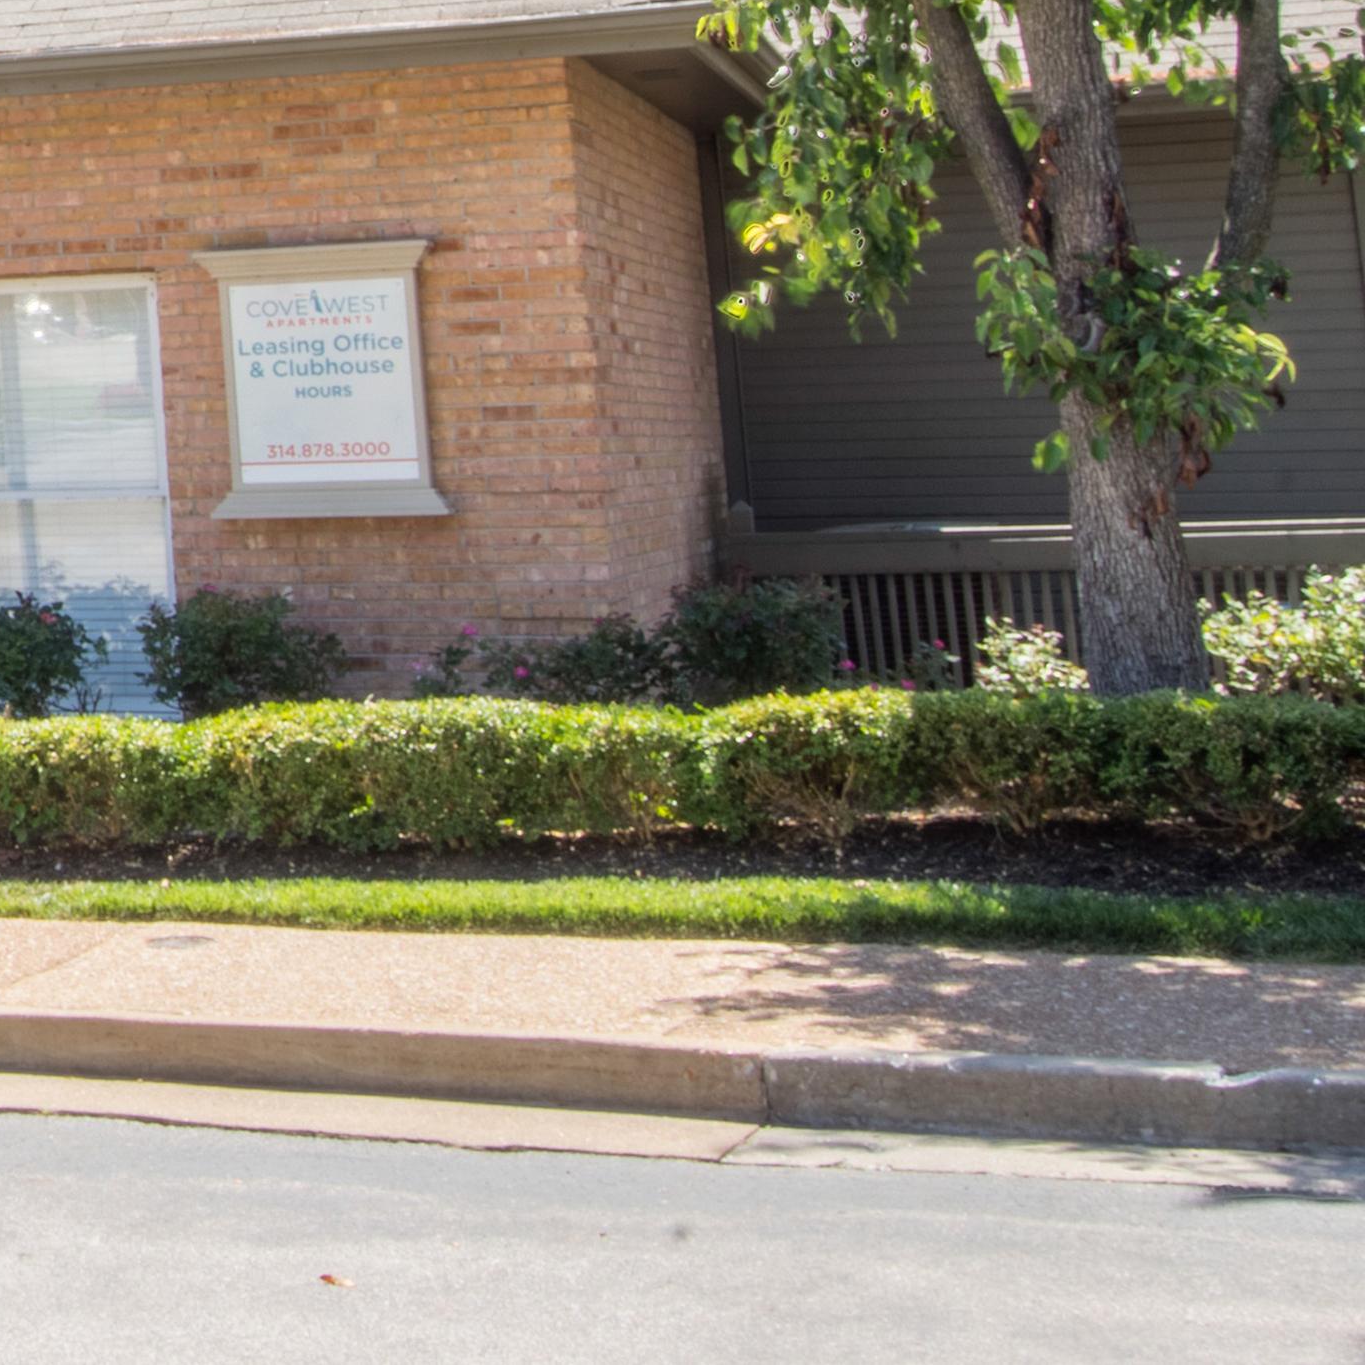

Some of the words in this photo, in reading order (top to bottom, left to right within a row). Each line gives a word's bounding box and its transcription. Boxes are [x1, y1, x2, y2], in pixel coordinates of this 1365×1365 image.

[246, 299, 307, 318] COVE
[323, 294, 388, 314] WEST
[266, 315, 373, 328] APARTMENTS
[238, 337, 325, 356] Leasing
[333, 333, 404, 352] Office
[249, 361, 264, 378] &
[272, 358, 394, 377] Clubhouse
[295, 385, 353, 398] HOURS
[267, 441, 391, 458] 314.878.3000
